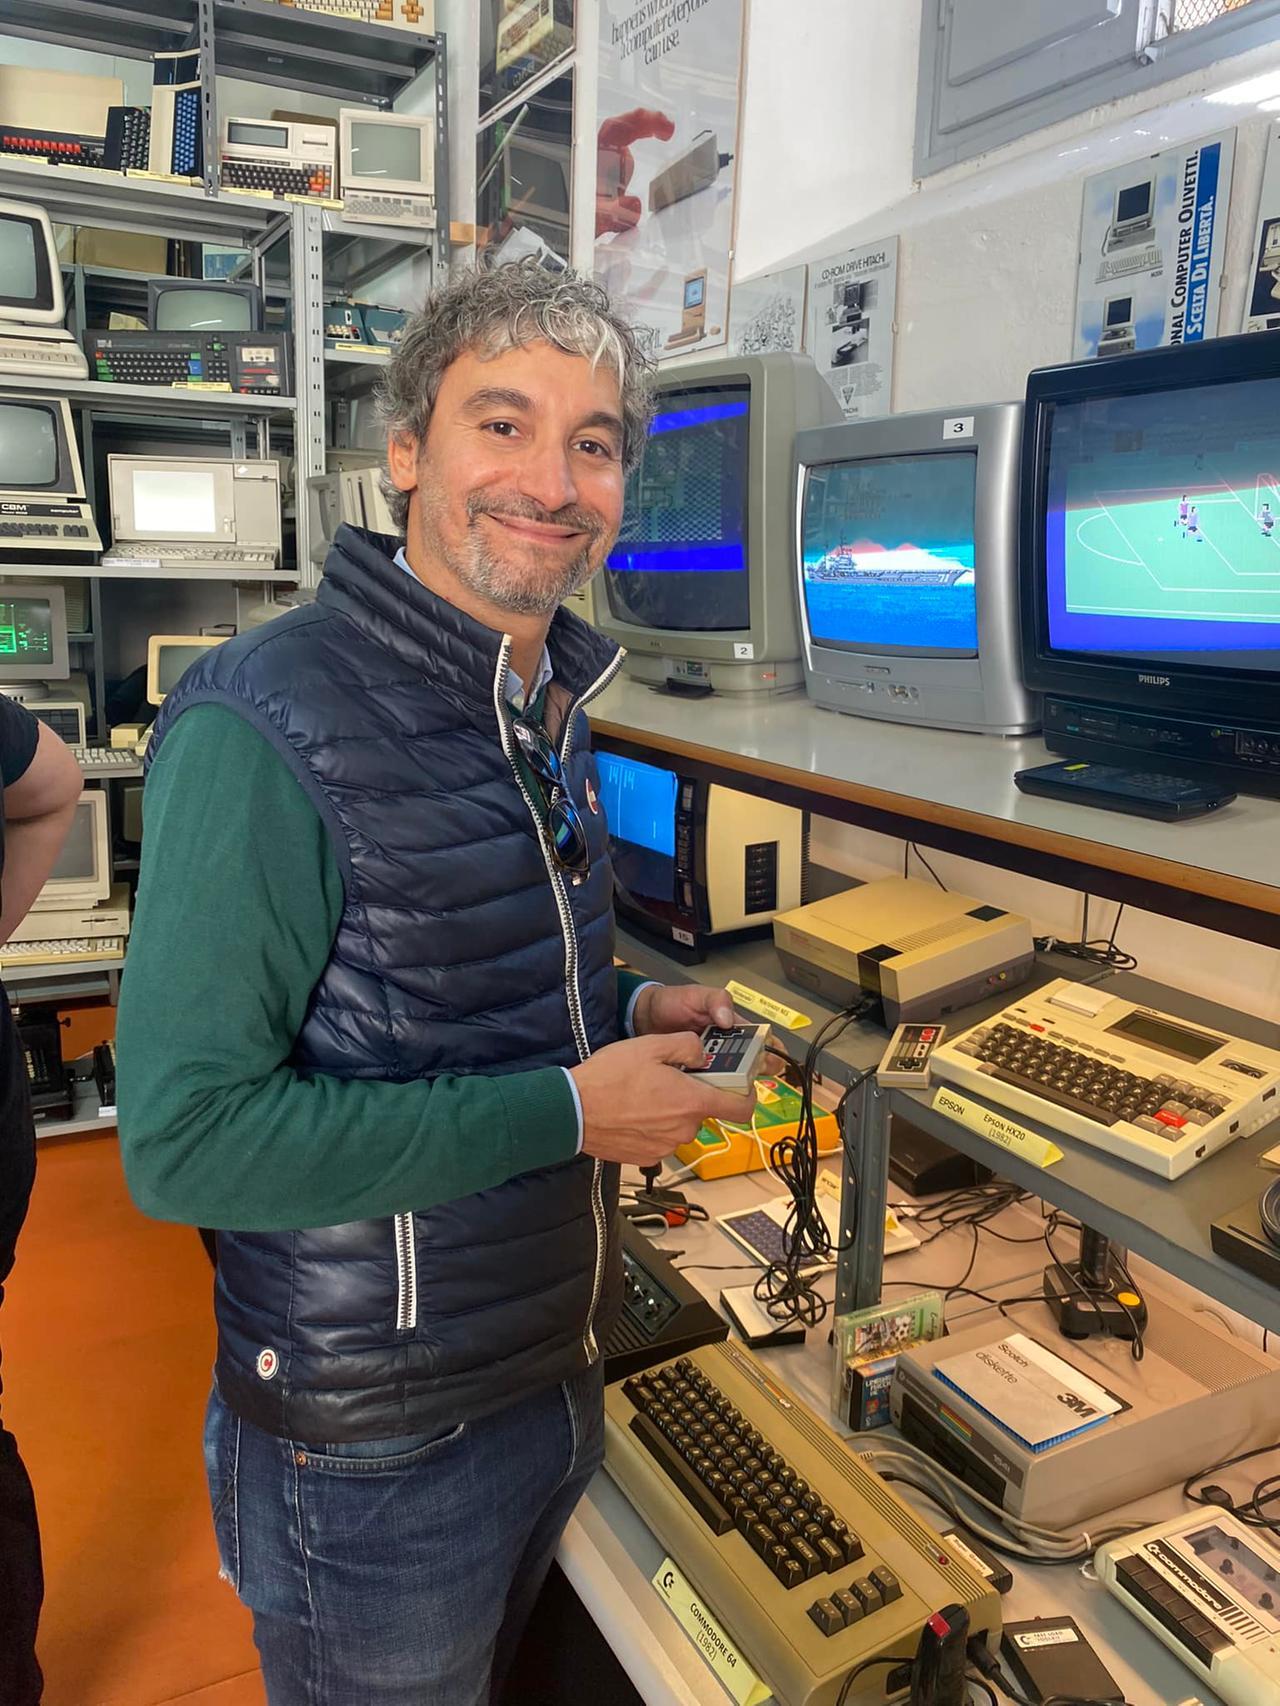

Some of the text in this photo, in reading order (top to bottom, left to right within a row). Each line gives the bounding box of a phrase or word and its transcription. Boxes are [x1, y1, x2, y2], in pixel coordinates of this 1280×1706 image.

[625, 14, 668, 56] computer
[644, 28, 680, 65] can use.
[1178, 149, 1199, 223] OLIVETTI.
[1171, 227, 1193, 308] COMPUTER
[1186, 283, 1206, 335] SCELTA
[953, 422, 964, 433] 3
[1, 503, 28, 511] CBM
[739, 646, 749, 655] 2
[1138, 674, 1171, 687] PHILIPS
[938, 1096, 1027, 1142] EPSON EPSON HX20
[988, 1128, 1012, 1147] (1982)
[975, 1351, 1018, 1384] diskette
[998, 1343, 1029, 1368] Scotch
[1057, 1392, 1098, 1418] 3M
[1158, 1553, 1223, 1610] commodore
[690, 1602, 738, 1669] COMMODORE 64
[696, 1629, 719, 1662] (1982)
